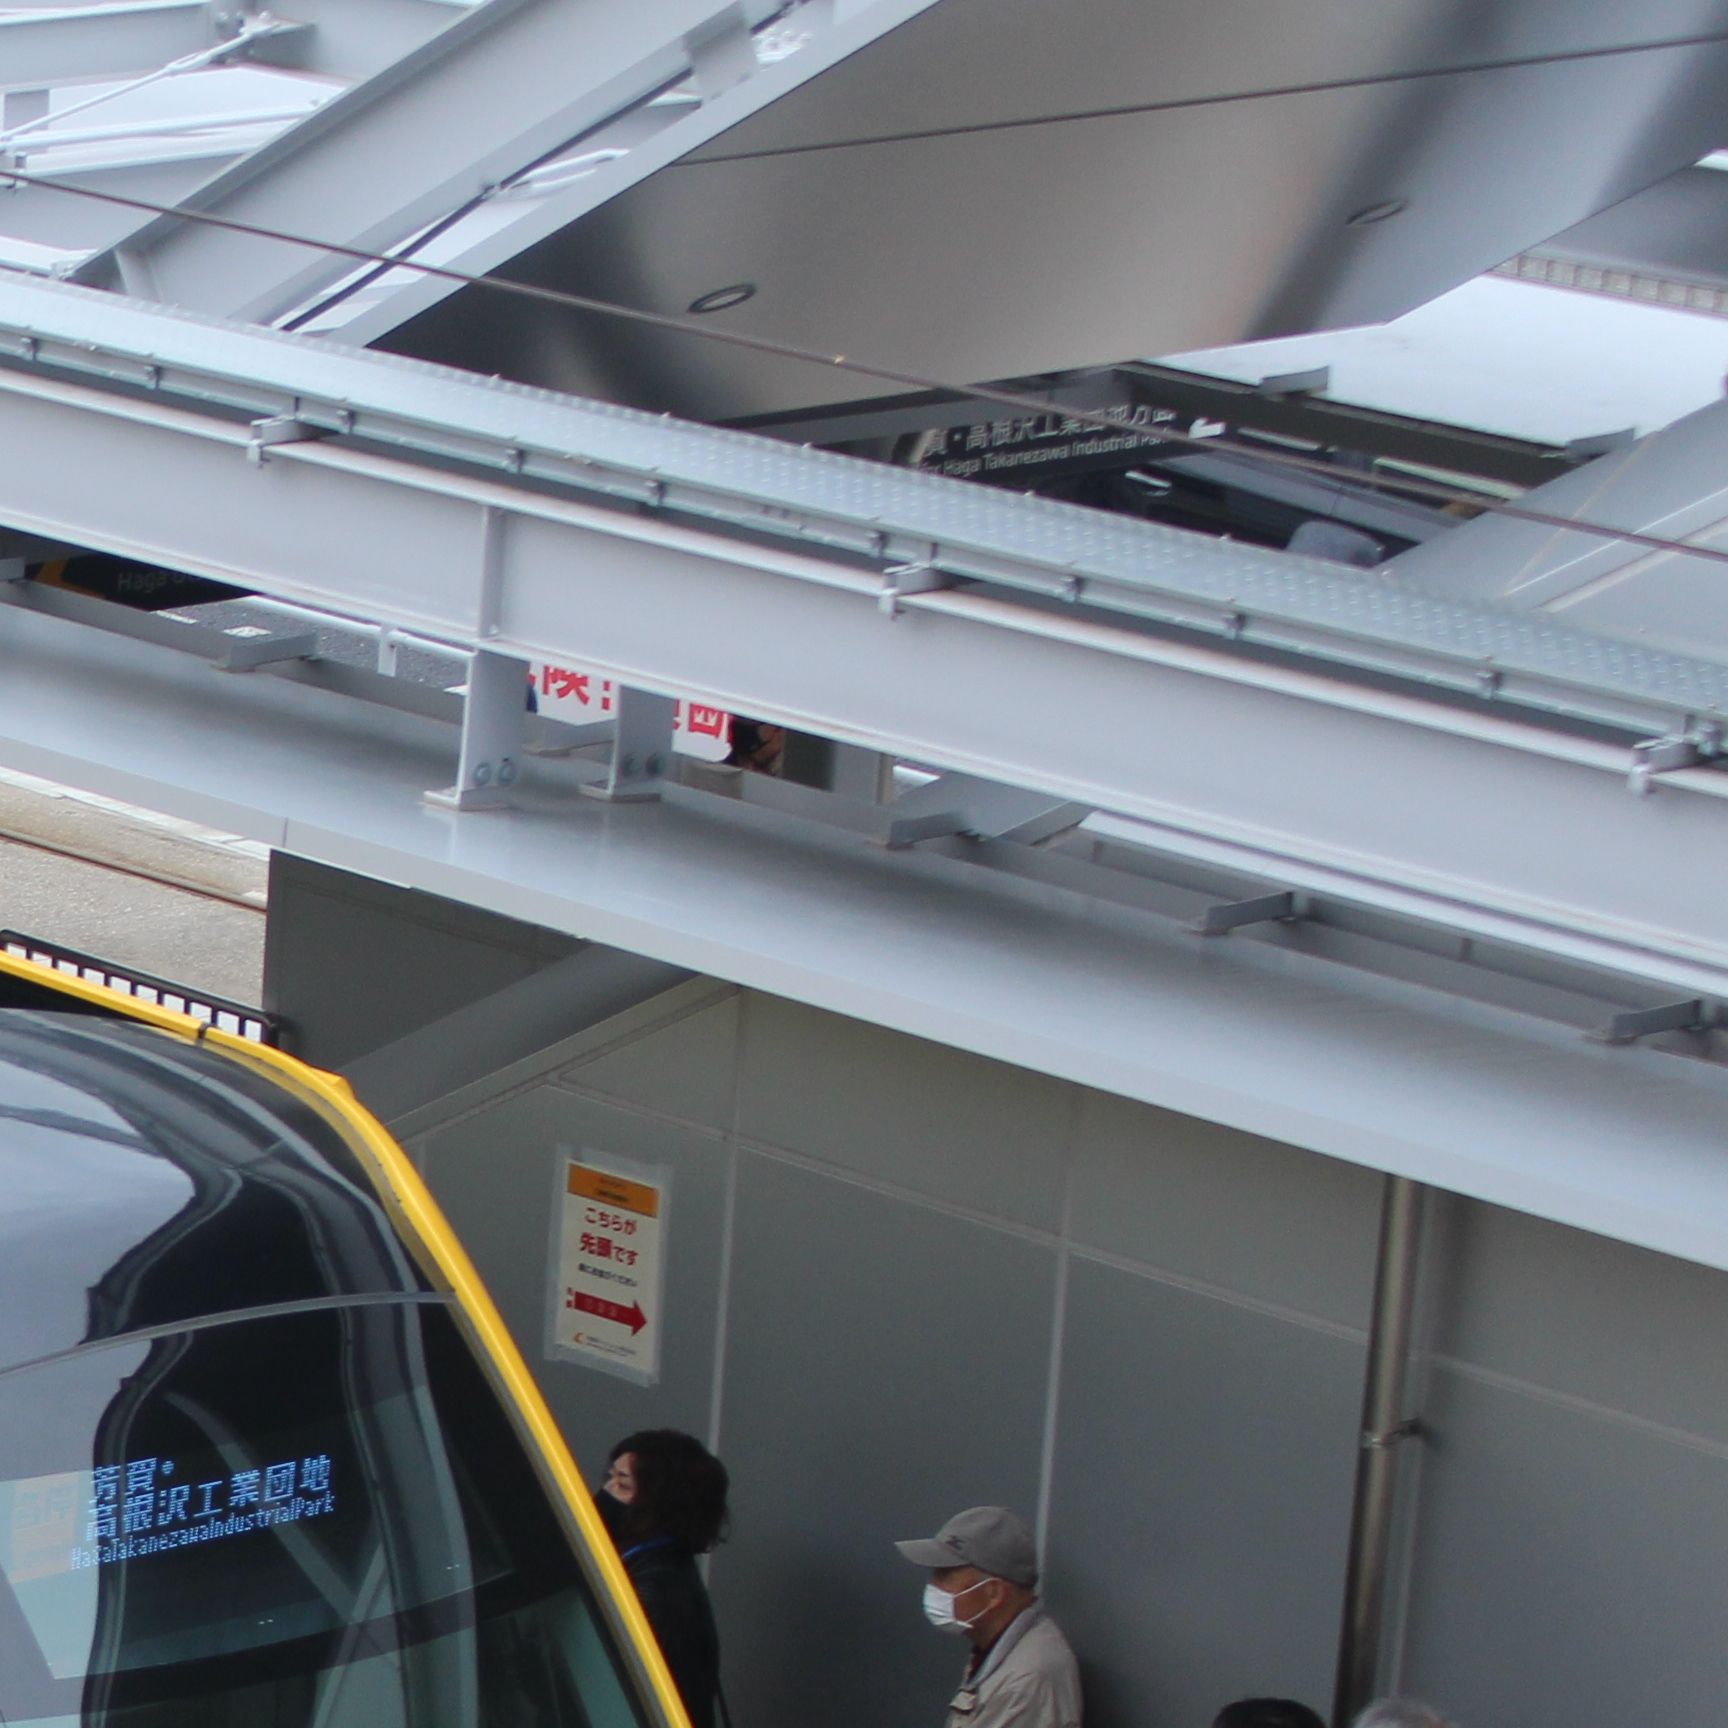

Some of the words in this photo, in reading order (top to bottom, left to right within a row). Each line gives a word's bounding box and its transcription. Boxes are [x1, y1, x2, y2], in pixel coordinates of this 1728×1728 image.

[584, 1207, 638, 1235] こちらが
[579, 1232, 640, 1265] 先頭です
